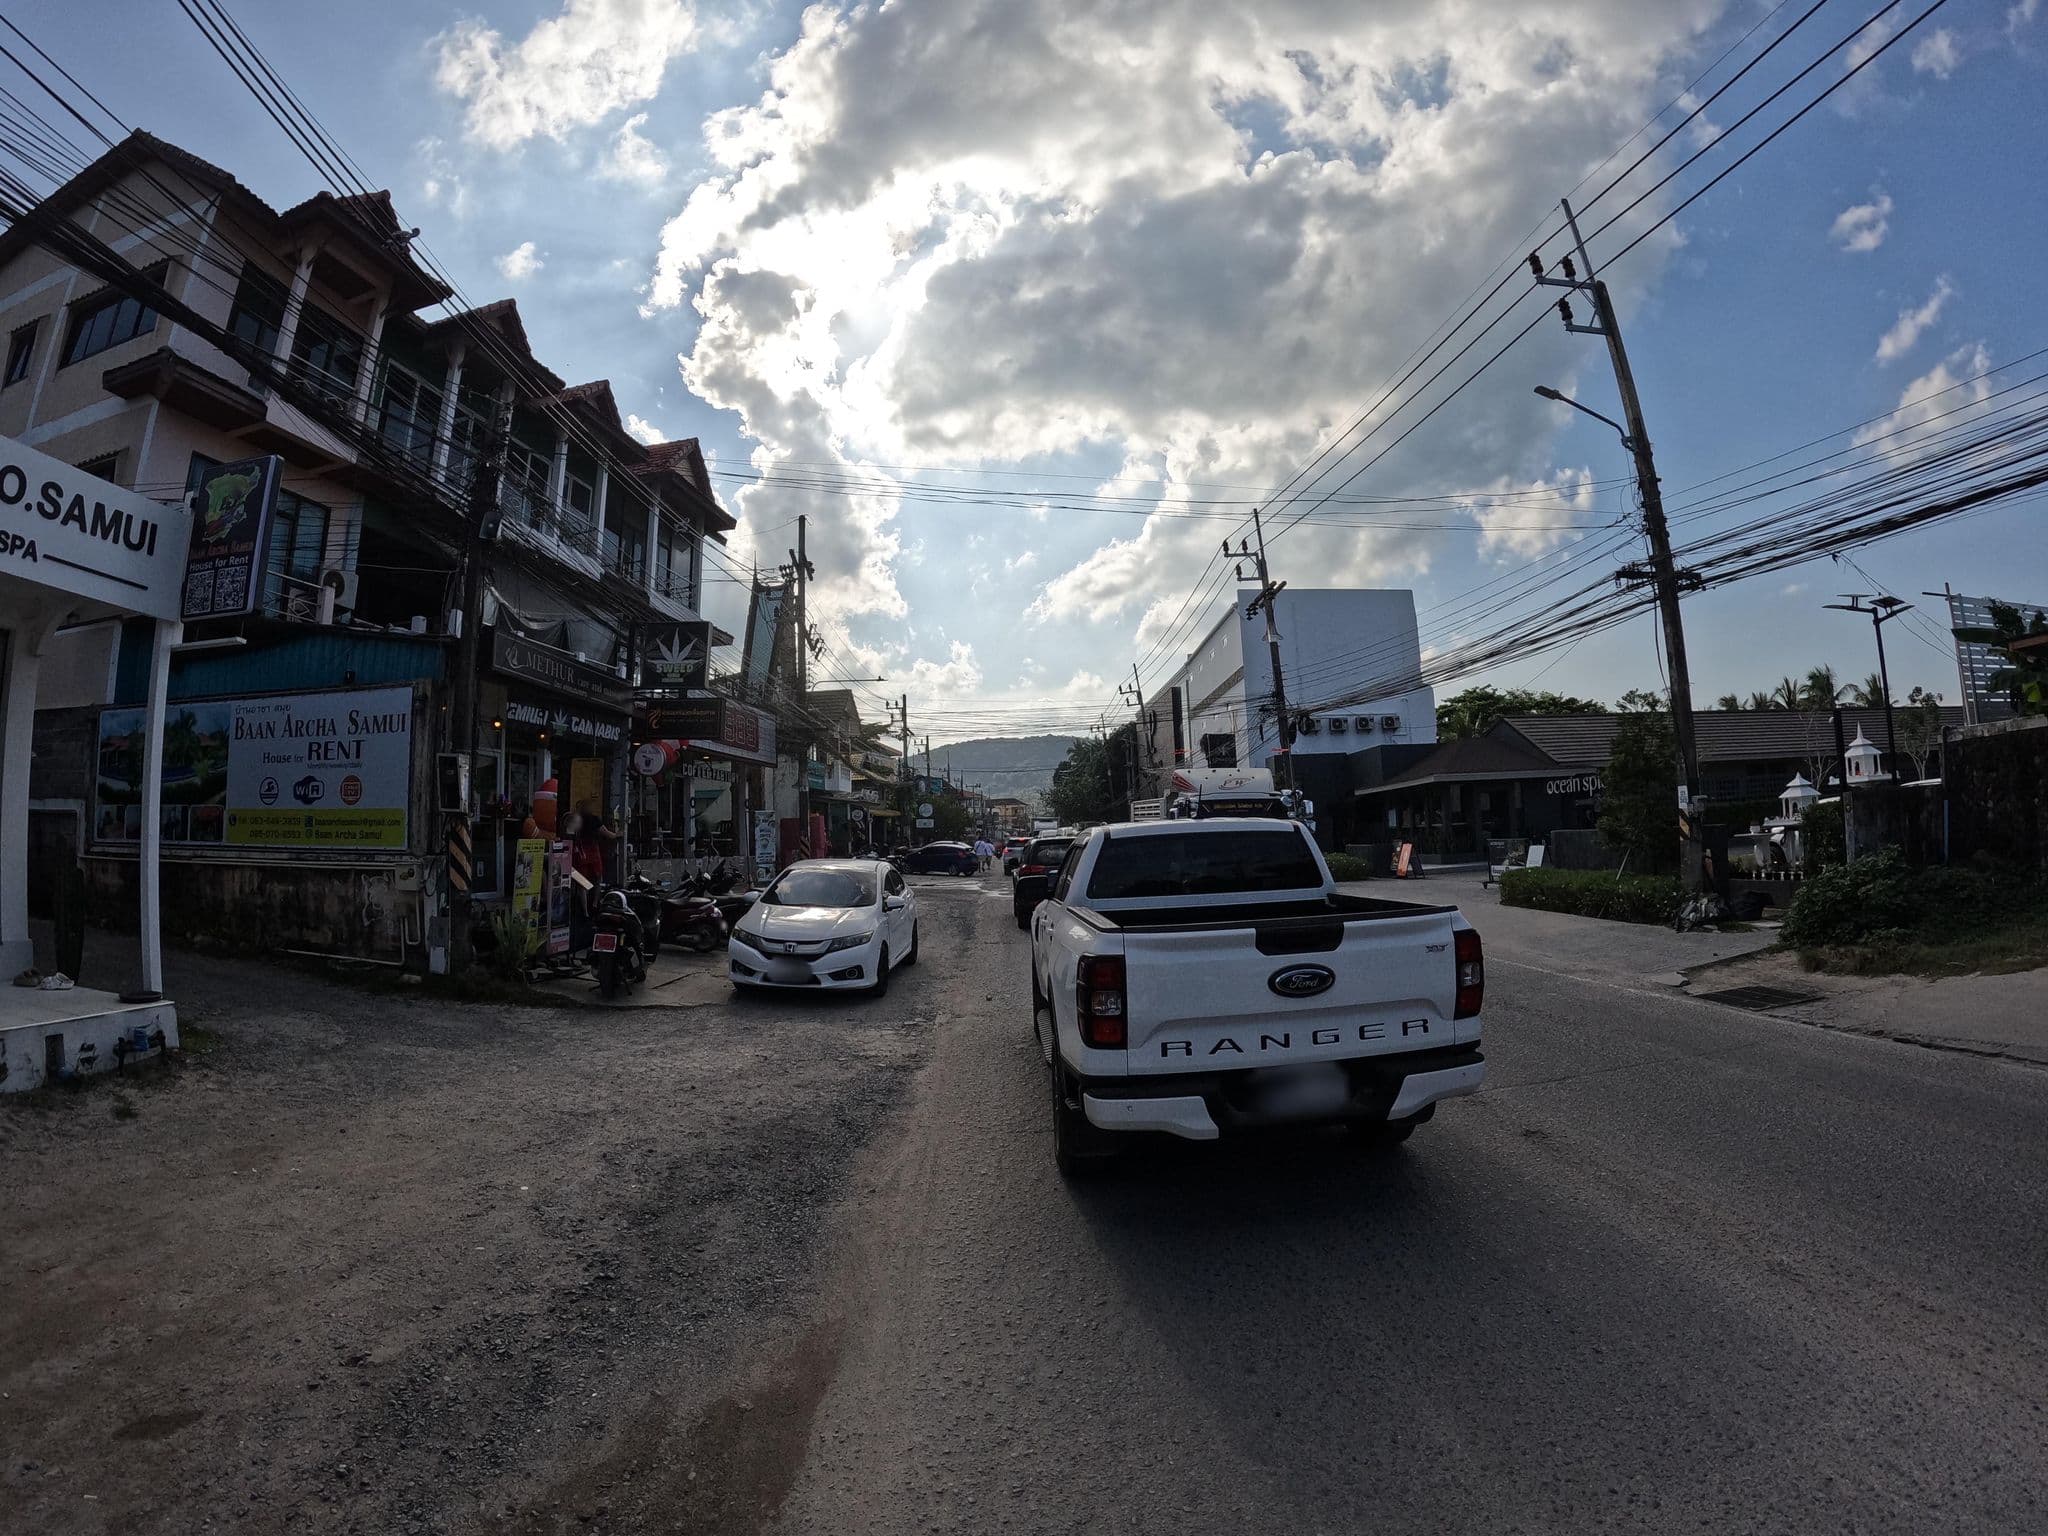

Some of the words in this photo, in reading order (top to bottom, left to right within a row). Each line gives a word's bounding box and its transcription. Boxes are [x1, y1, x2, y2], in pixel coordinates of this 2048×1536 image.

[0, 465, 157, 556] O.SAMUI
[0, 530, 38, 563] SPA
[190, 560, 213, 572] House
[215, 557, 227, 568] for
[229, 555, 249, 566] Rent
[262, 752, 292, 764] House
[307, 739, 366, 761] RENT
[1546, 777, 1581, 795] ocean
[1289, 974, 1321, 989] Ford
[1160, 1017, 1430, 1058] RANGER
